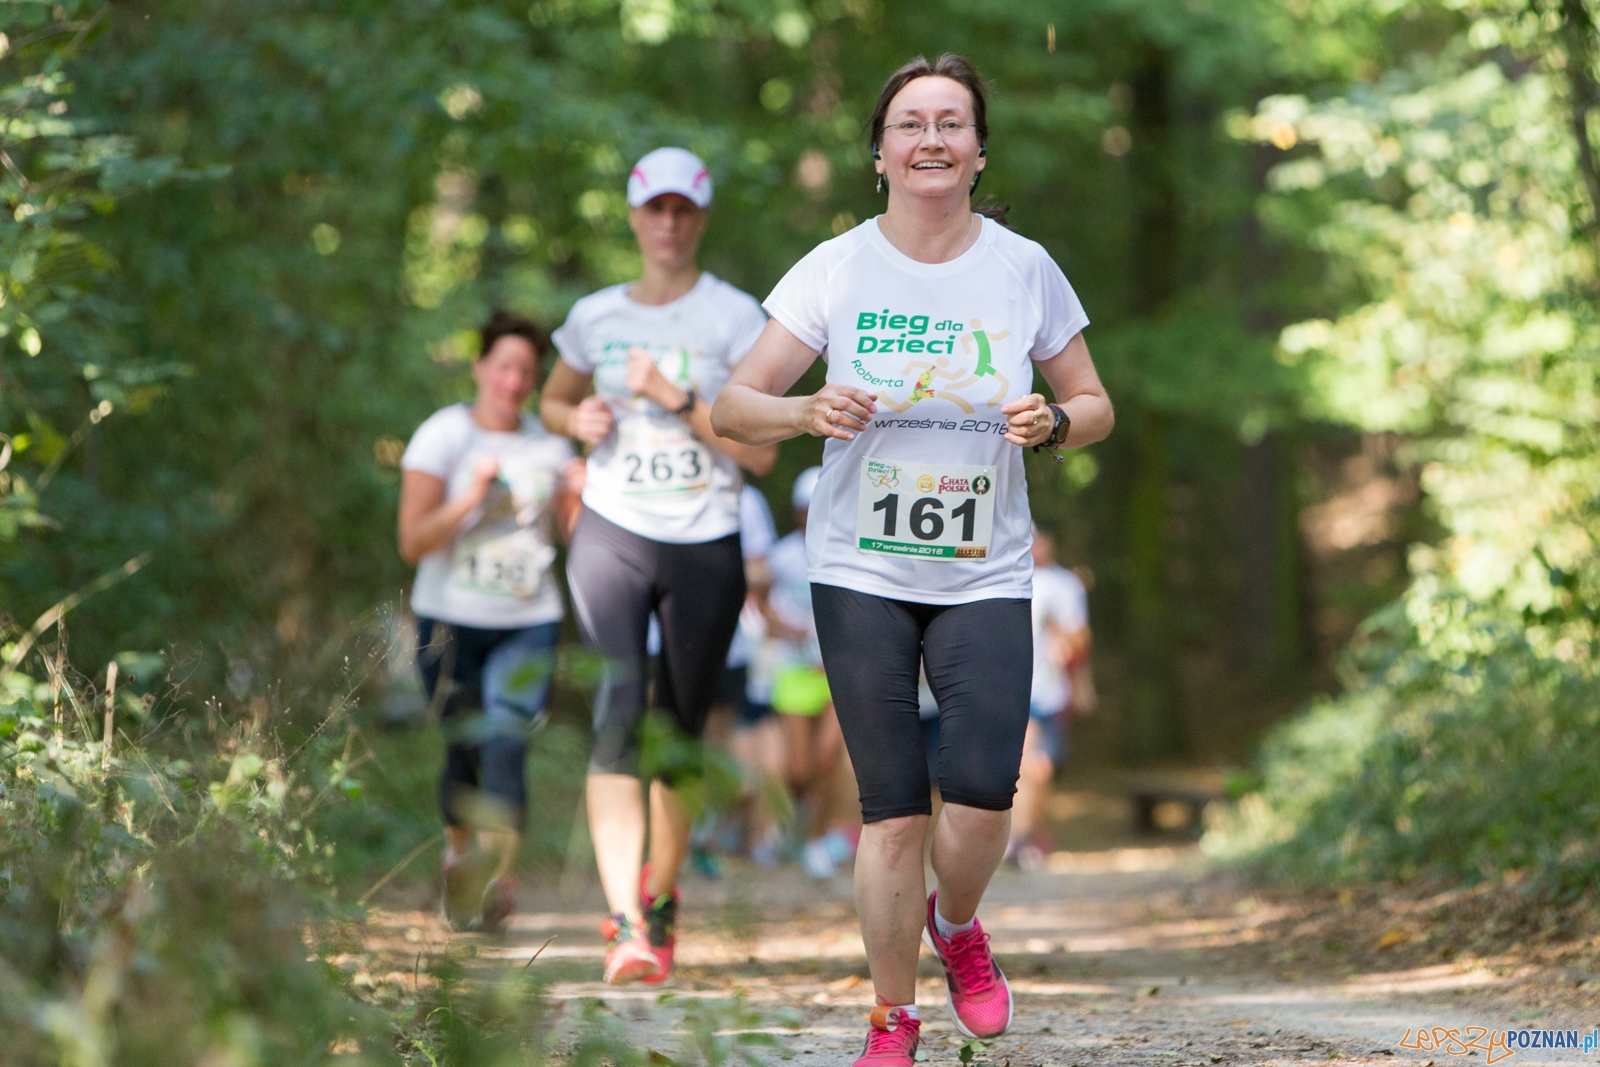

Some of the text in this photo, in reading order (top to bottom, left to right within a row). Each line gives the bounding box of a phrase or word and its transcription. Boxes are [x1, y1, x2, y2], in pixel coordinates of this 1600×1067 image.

[856, 309, 963, 335] Bieg dla
[856, 333, 956, 354] Dzieci
[851, 359, 904, 388] Roberta
[874, 418, 957, 431] września
[959, 419, 1009, 435] 2016
[624, 449, 702, 483] 263
[867, 467, 889, 475] Dzieci
[938, 484, 971, 494] POLSKA
[940, 475, 969, 486] CHATA
[873, 493, 976, 542] 161
[871, 541, 882, 549] 17
